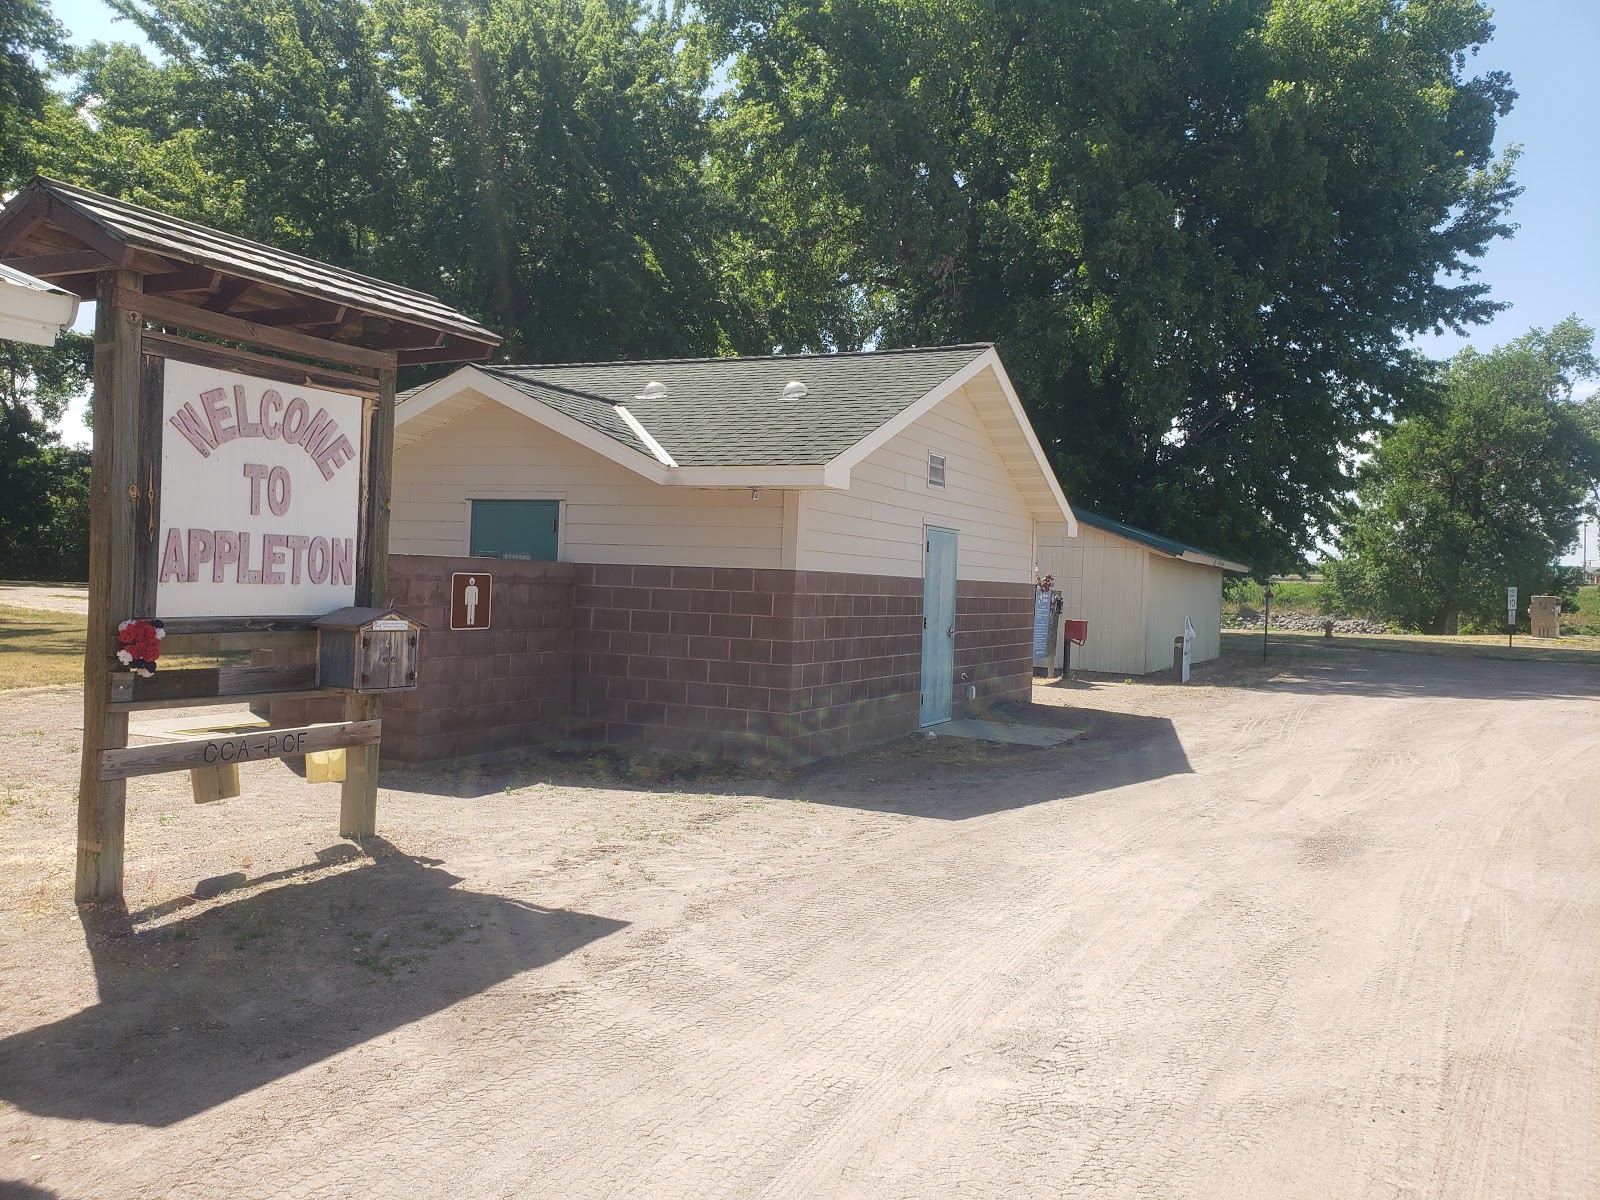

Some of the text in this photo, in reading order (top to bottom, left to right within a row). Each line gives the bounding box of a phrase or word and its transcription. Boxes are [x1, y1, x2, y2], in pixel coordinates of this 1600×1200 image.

[169, 385, 356, 481] WELCOME
[244, 463, 292, 516] TO
[159, 528, 353, 585] APPLETON
[203, 732, 308, 763] CCA-PCF
